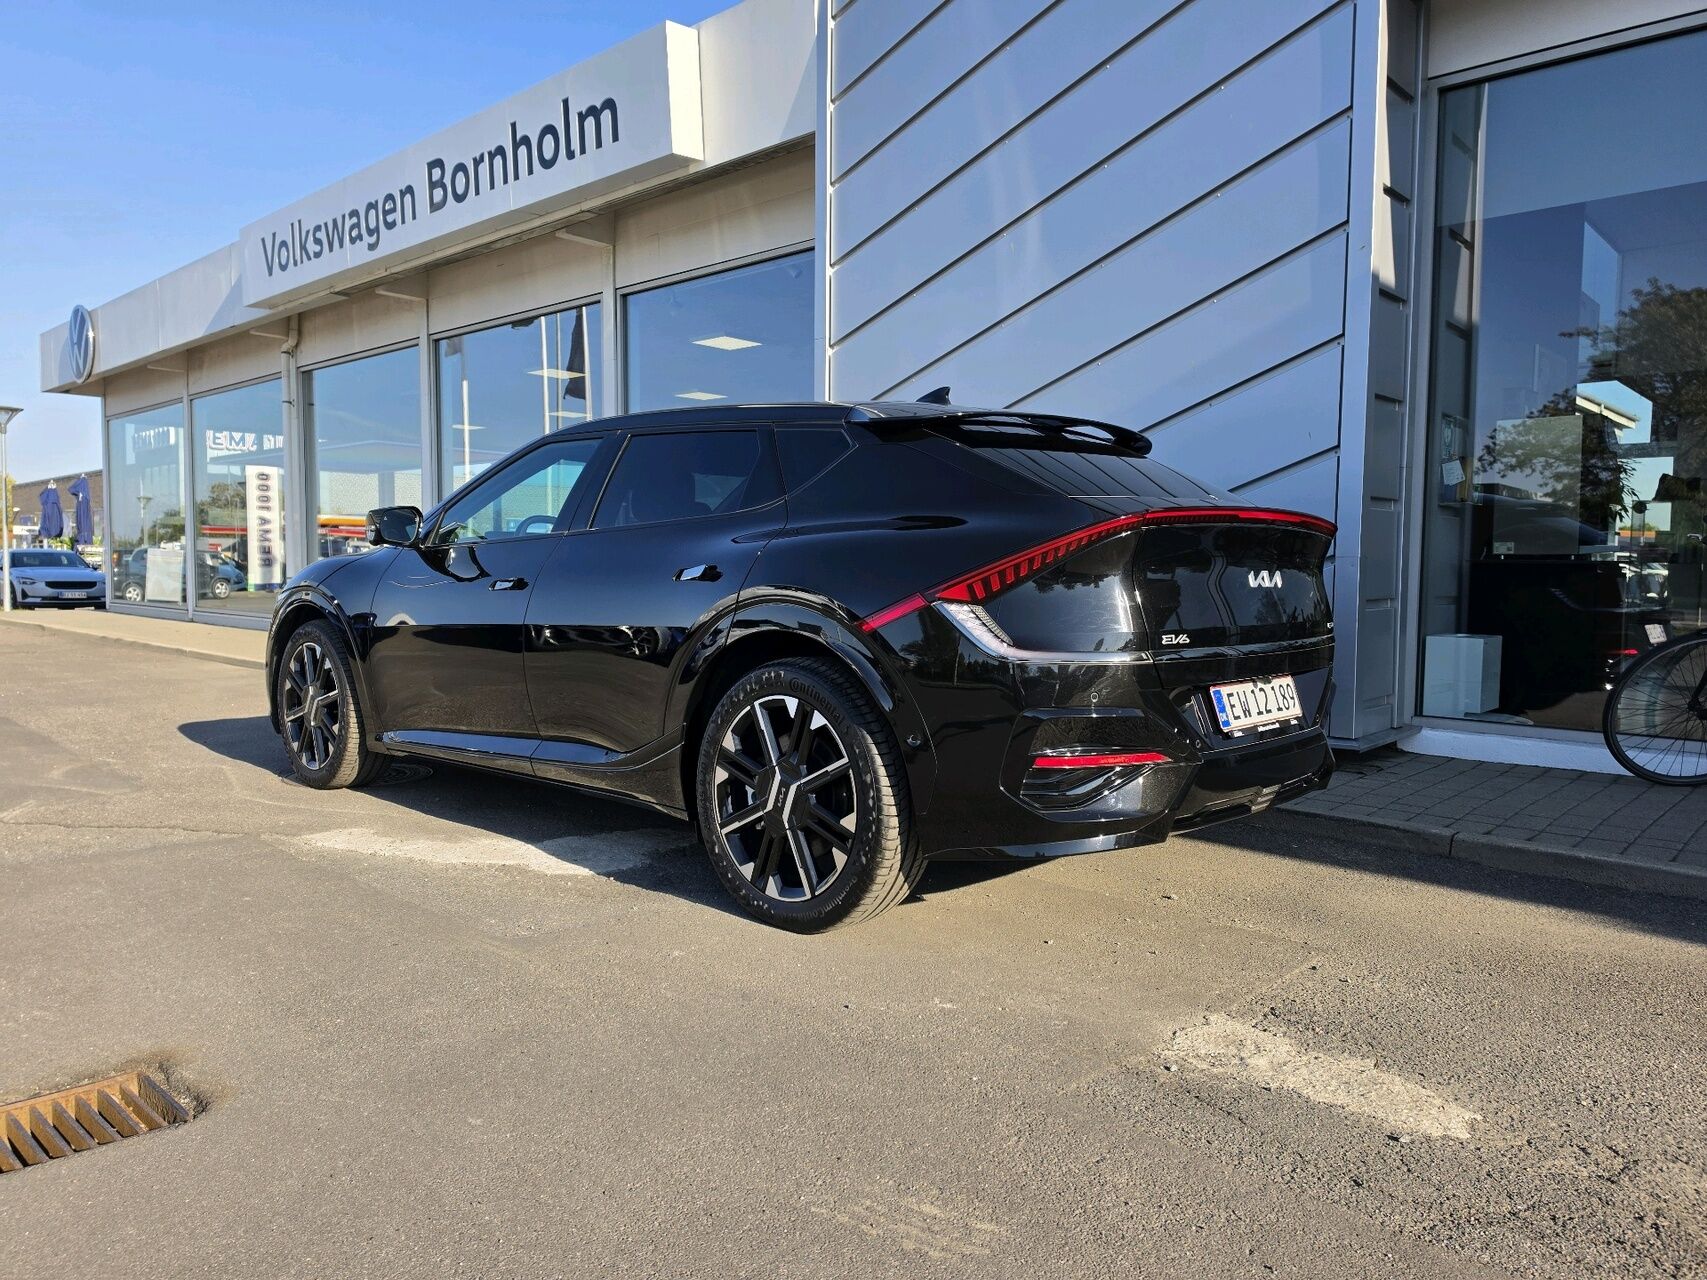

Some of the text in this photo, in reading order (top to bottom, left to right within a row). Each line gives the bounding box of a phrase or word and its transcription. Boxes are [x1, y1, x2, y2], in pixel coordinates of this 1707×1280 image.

[261, 96, 620, 277] Volkswagen Bornholm
[1248, 570, 1283, 588] KIA
[1161, 633, 1190, 645] EV6
[1226, 682, 1296, 721] EW 12 189
